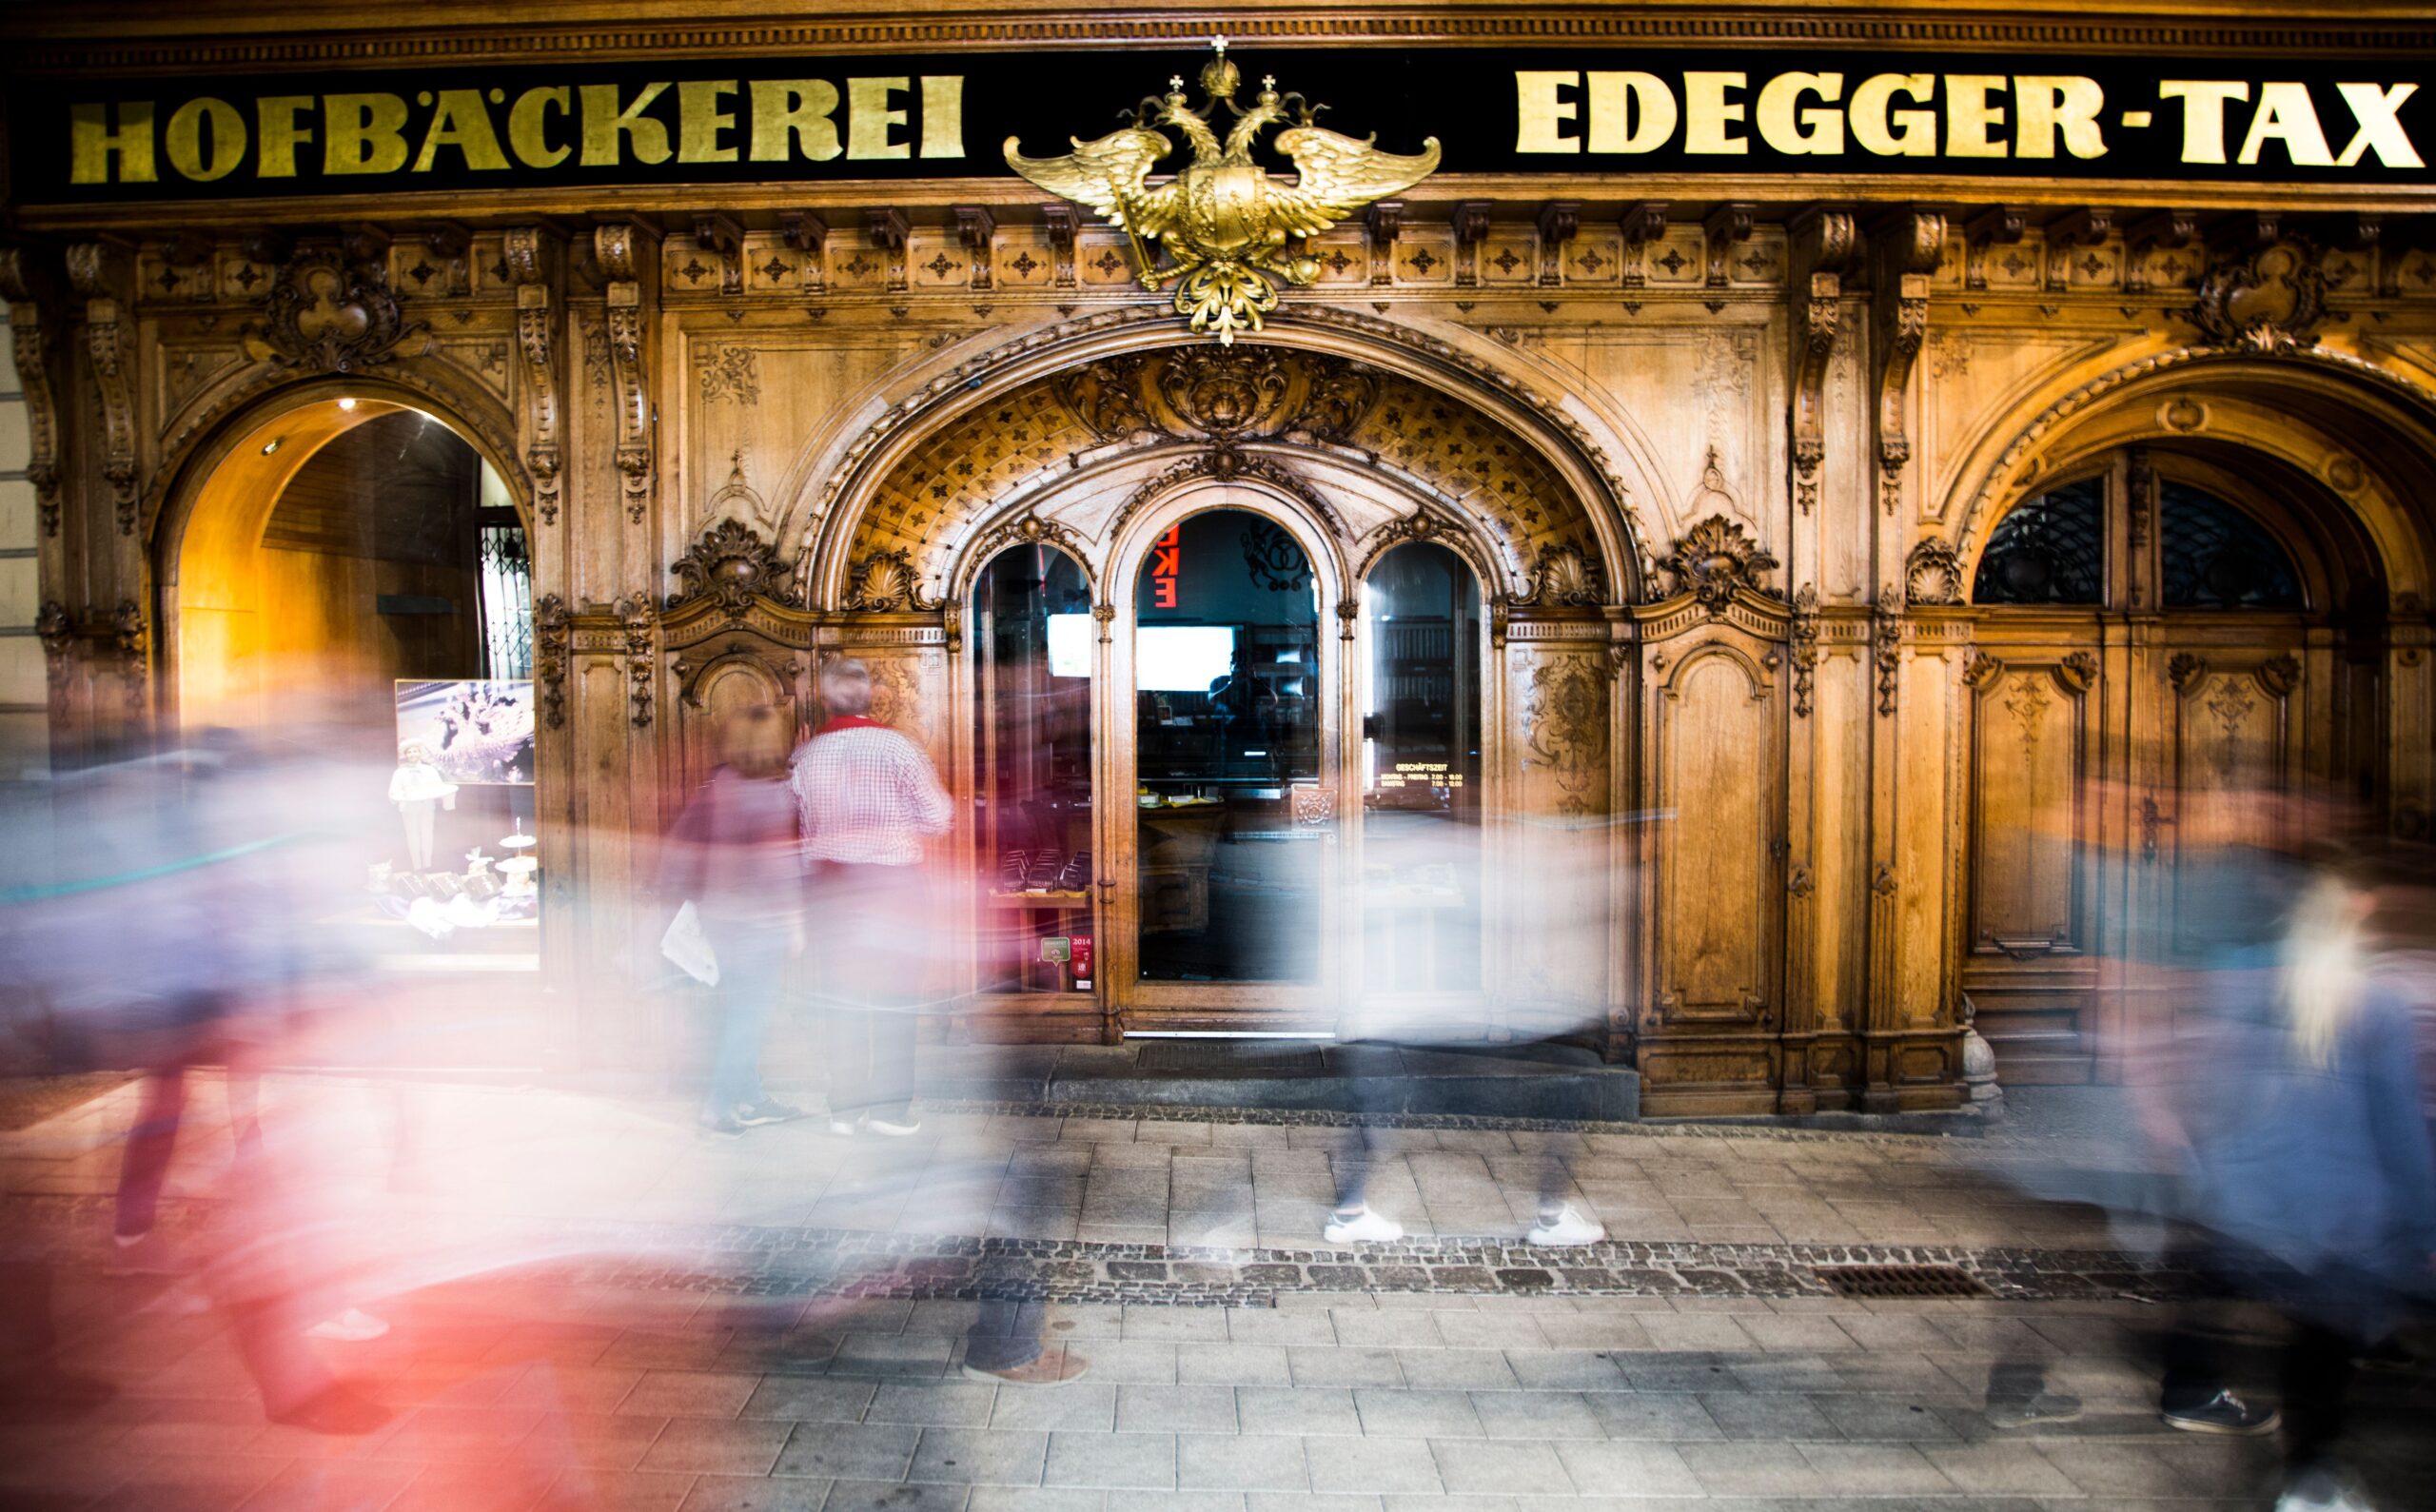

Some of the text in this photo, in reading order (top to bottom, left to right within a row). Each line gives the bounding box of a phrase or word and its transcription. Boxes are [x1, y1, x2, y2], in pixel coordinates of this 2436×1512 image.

[70, 75, 966, 184] HOFBÄCKEREI
[1515, 70, 2426, 168] EDEGGER-TAX
[1395, 762, 1448, 772] GESCHÄFTSZEIT
[1072, 937, 1091, 946] 2014
